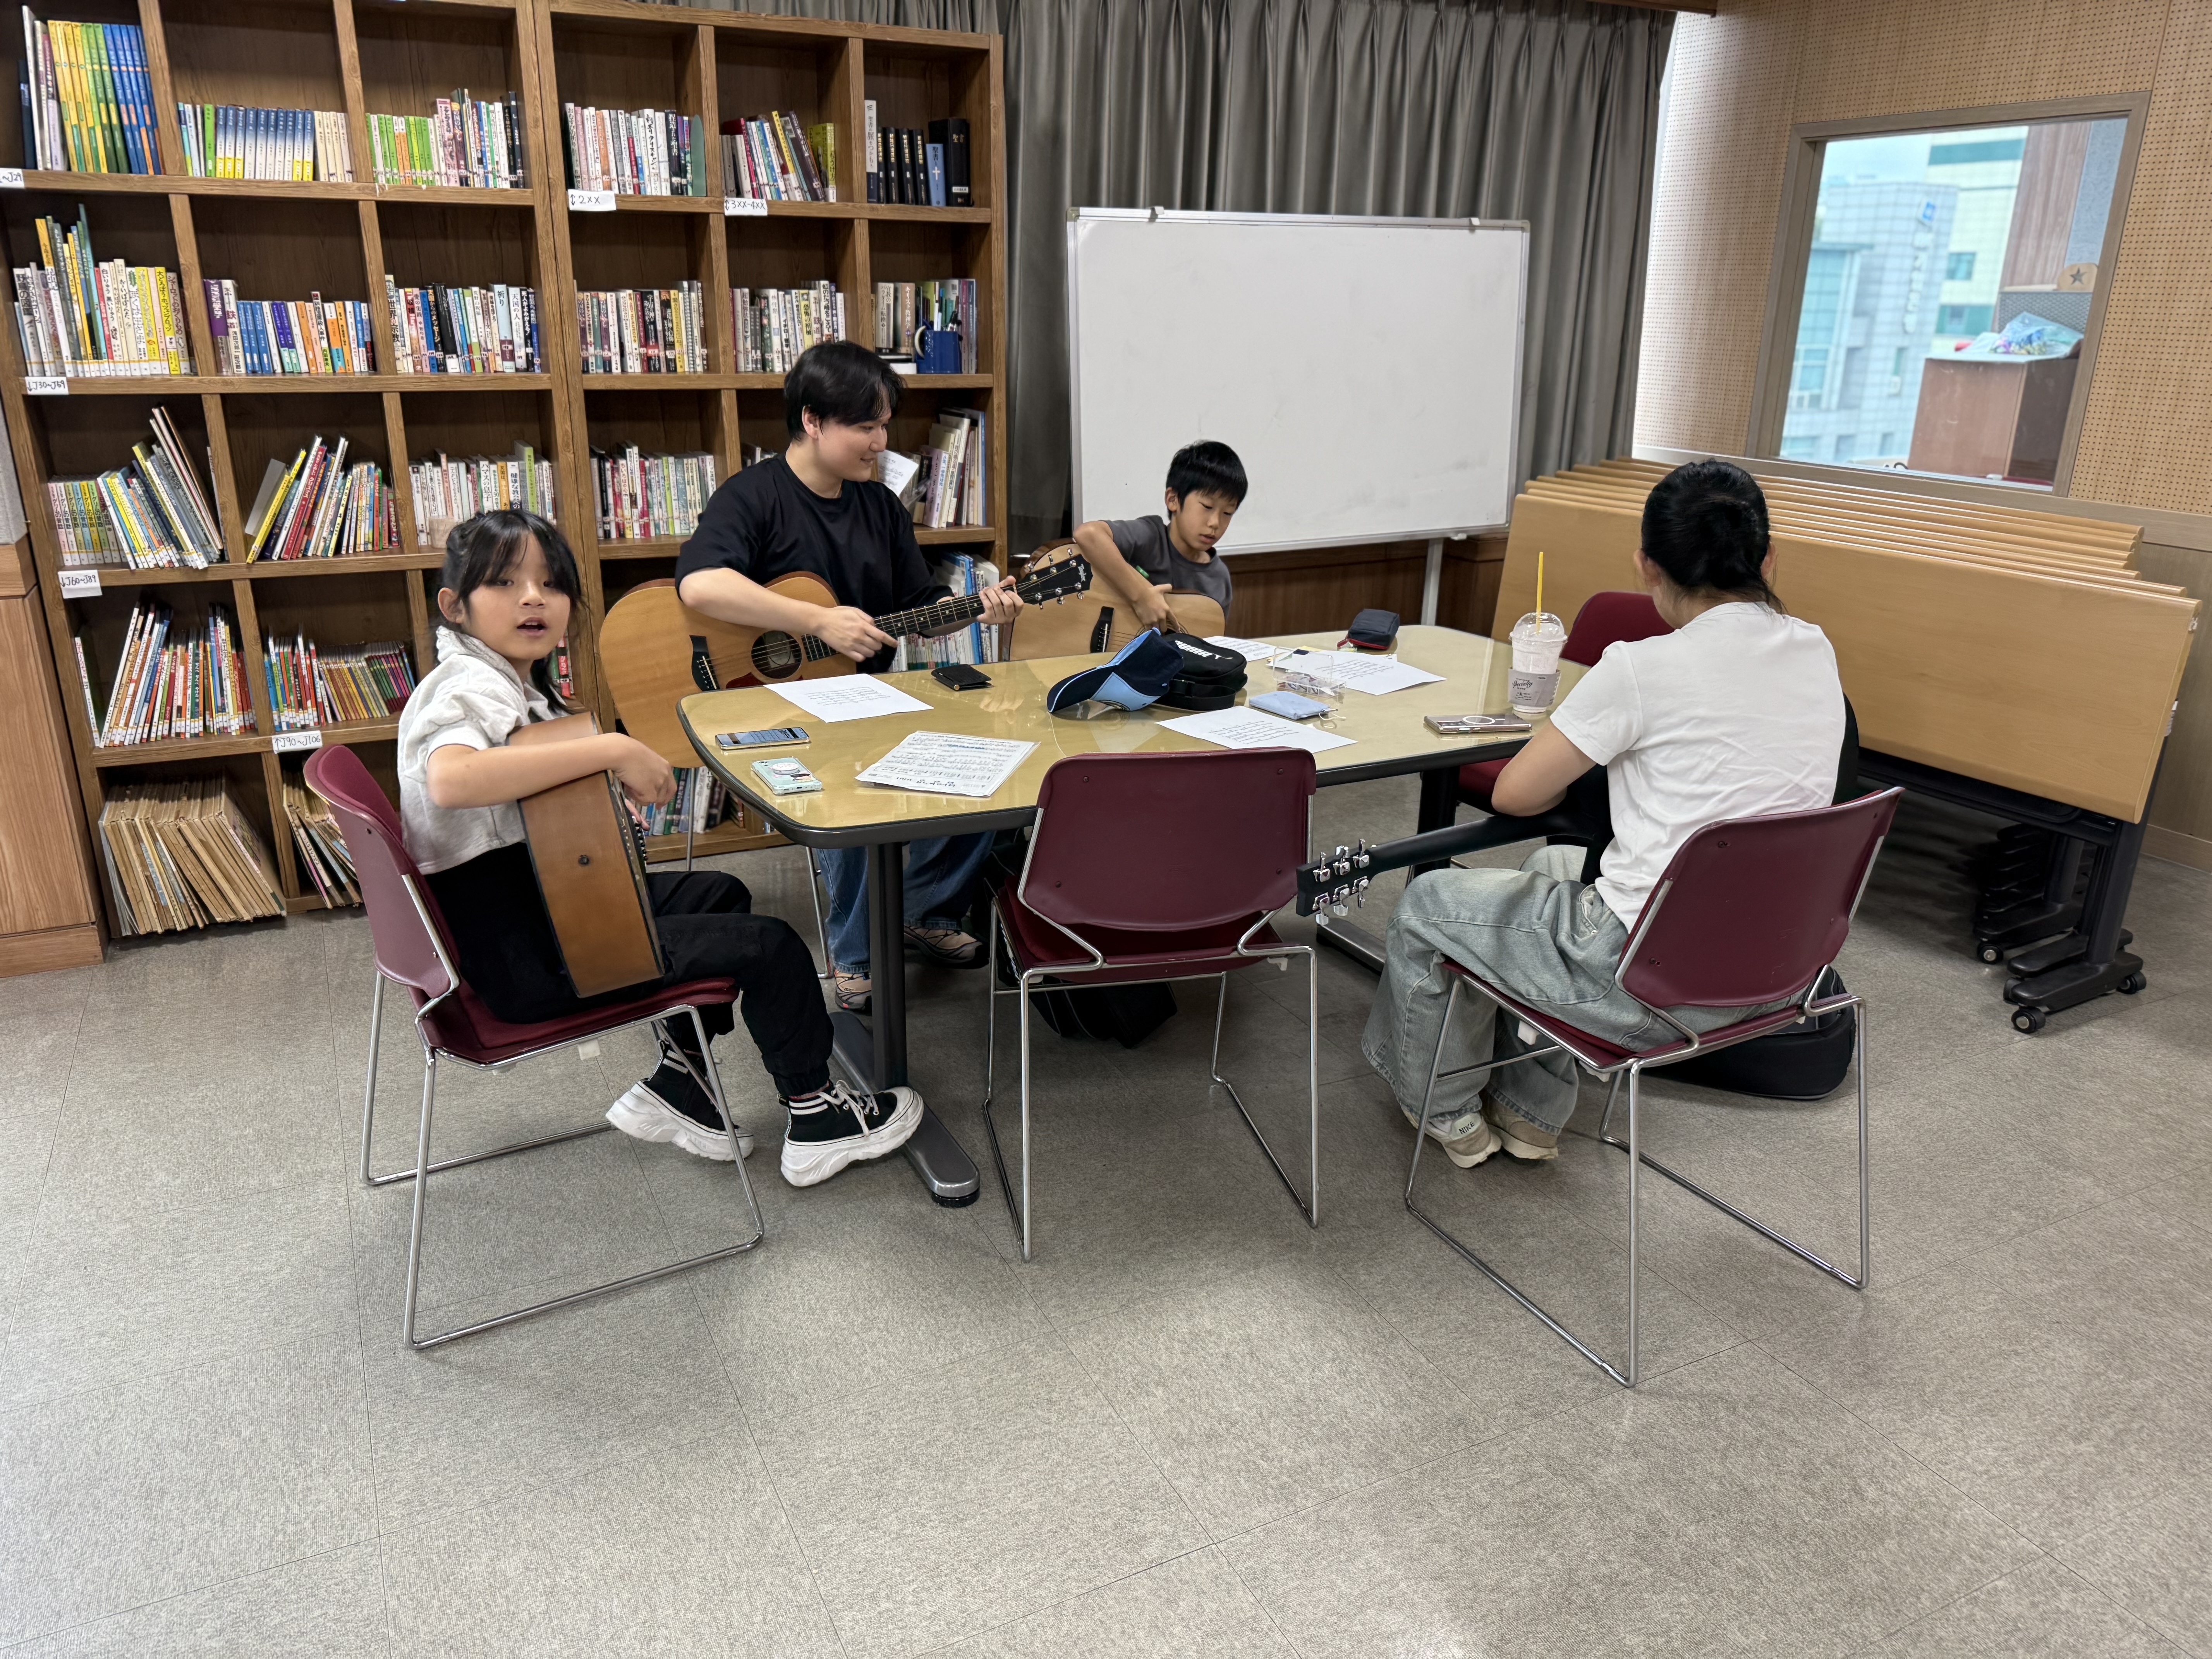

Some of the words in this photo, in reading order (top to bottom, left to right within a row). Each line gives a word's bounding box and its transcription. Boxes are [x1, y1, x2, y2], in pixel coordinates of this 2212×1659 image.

[669, 113, 678, 156] 捏造された聖書
[932, 146, 939, 161] 聖書
[16, 274, 33, 316] 野鳥の図鑑
[101, 269, 110, 294] 白いりゅう
[168, 276, 183, 335] シャーロットのおくりもの
[414, 294, 422, 318] 愛の実践
[497, 290, 505, 306] 祈り
[511, 293, 520, 320] 天国の人
[129, 290, 146, 344] ぼくは王さま
[388, 300, 400, 343] 世界の宗教
[428, 289, 440, 342] 天国からのメッセージ
[481, 464, 491, 501] ハマスの息子
[52, 498, 64, 529] グリムの昔話
[61, 498, 72, 529] グリムの昔話
[69, 497, 80, 528] グリムの昔話
[77, 497, 88, 528] グリムの昔話
[84, 497, 96, 527] グリムの昔話
[92, 496, 103, 527] グリムの昔話
[1459, 1121, 1475, 1134] NIKE
